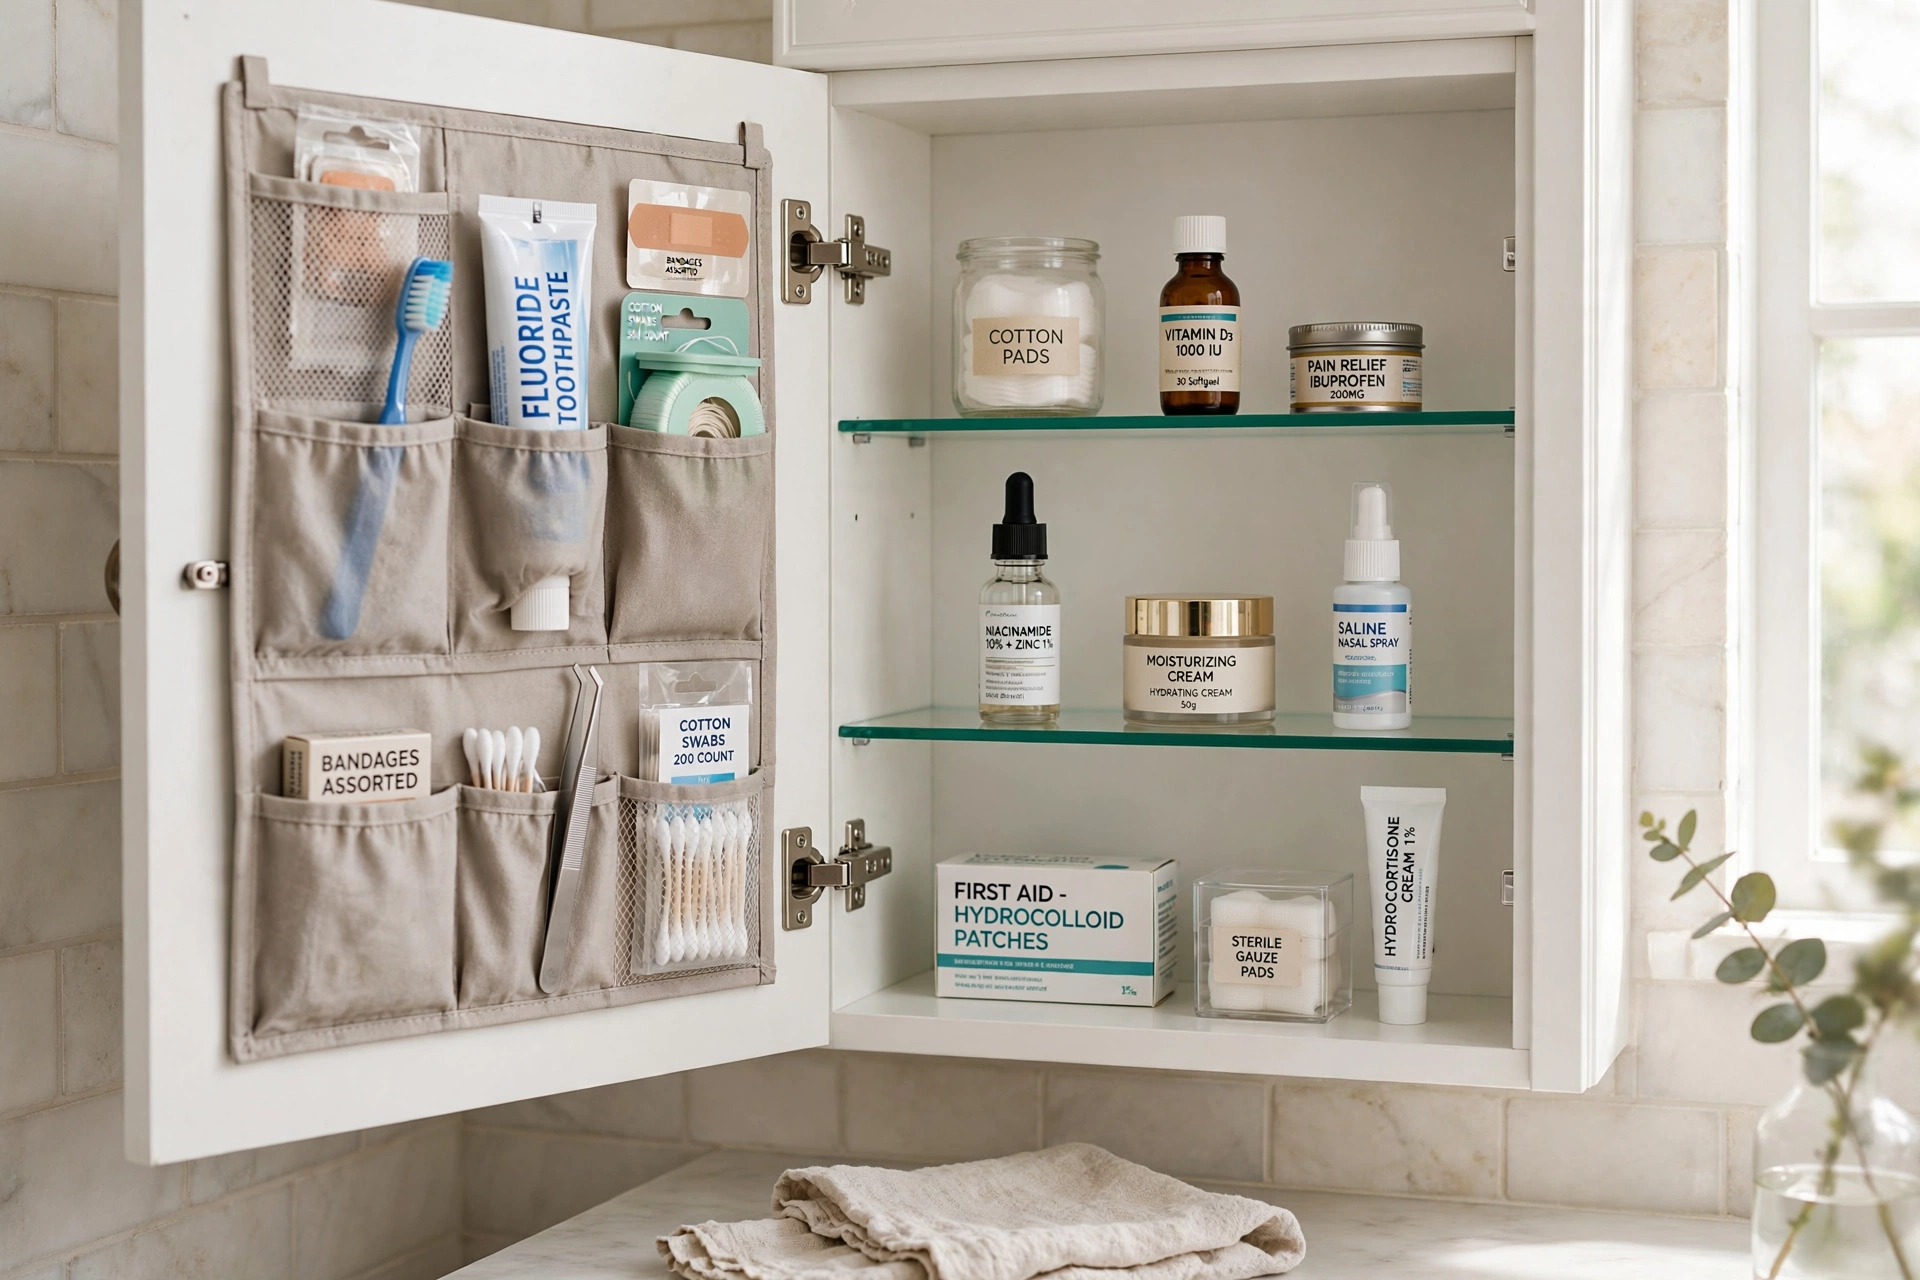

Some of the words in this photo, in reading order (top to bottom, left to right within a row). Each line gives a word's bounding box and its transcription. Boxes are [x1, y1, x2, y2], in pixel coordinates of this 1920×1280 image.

[989, 329, 1063, 344] COTTON
[1164, 328, 1216, 341] VITAMIN
[514, 276, 550, 418] FLUORIDE
[546, 271, 577, 425] TOOTHPASTE
[1176, 344, 1205, 356] 1000
[1209, 344, 1222, 356] IU
[1003, 348, 1050, 365] PADS
[1308, 359, 1336, 372] PAIN
[1340, 358, 1387, 371] RELIEF
[1176, 377, 1186, 386] 30
[1310, 374, 1385, 388] IBUPROFEN
[1330, 390, 1365, 399] 200MG
[985, 625, 1052, 637] NIACINAMIDE
[1338, 621, 1387, 635] SALINE
[985, 638, 1003, 650] 10%
[1006, 641, 1012, 649] +
[1015, 639, 1041, 650] ZINC
[1338, 638, 1368, 648] NASAL
[1370, 638, 1399, 648] SPRAY
[1146, 655, 1236, 667] MOISTURIZING
[1167, 671, 1214, 683] CREAM
[1149, 688, 1199, 698] HYDRATING
[1200, 688, 1233, 697] CREAM
[1181, 700, 1197, 710] 50g
[679, 717, 731, 732] COTTON
[682, 734, 725, 749] SWABS
[322, 749, 419, 772] BANDAGES
[673, 753, 694, 766] 200
[697, 750, 734, 764] COUNT
[322, 772, 418, 795] ASSORTED
[1403, 826, 1416, 845] 1%
[1401, 852, 1415, 903] CREAM
[954, 881, 1011, 901] FIRST
[1017, 884, 1053, 902] AID
[1385, 816, 1400, 957] HYDROCORTISONE
[954, 905, 1124, 929] HYDROCOLLOID
[954, 929, 1049, 951] PATCHES
[1232, 935, 1282, 949] STERILE
[1236, 950, 1278, 964] GAUZE
[1241, 966, 1275, 979] PADS
